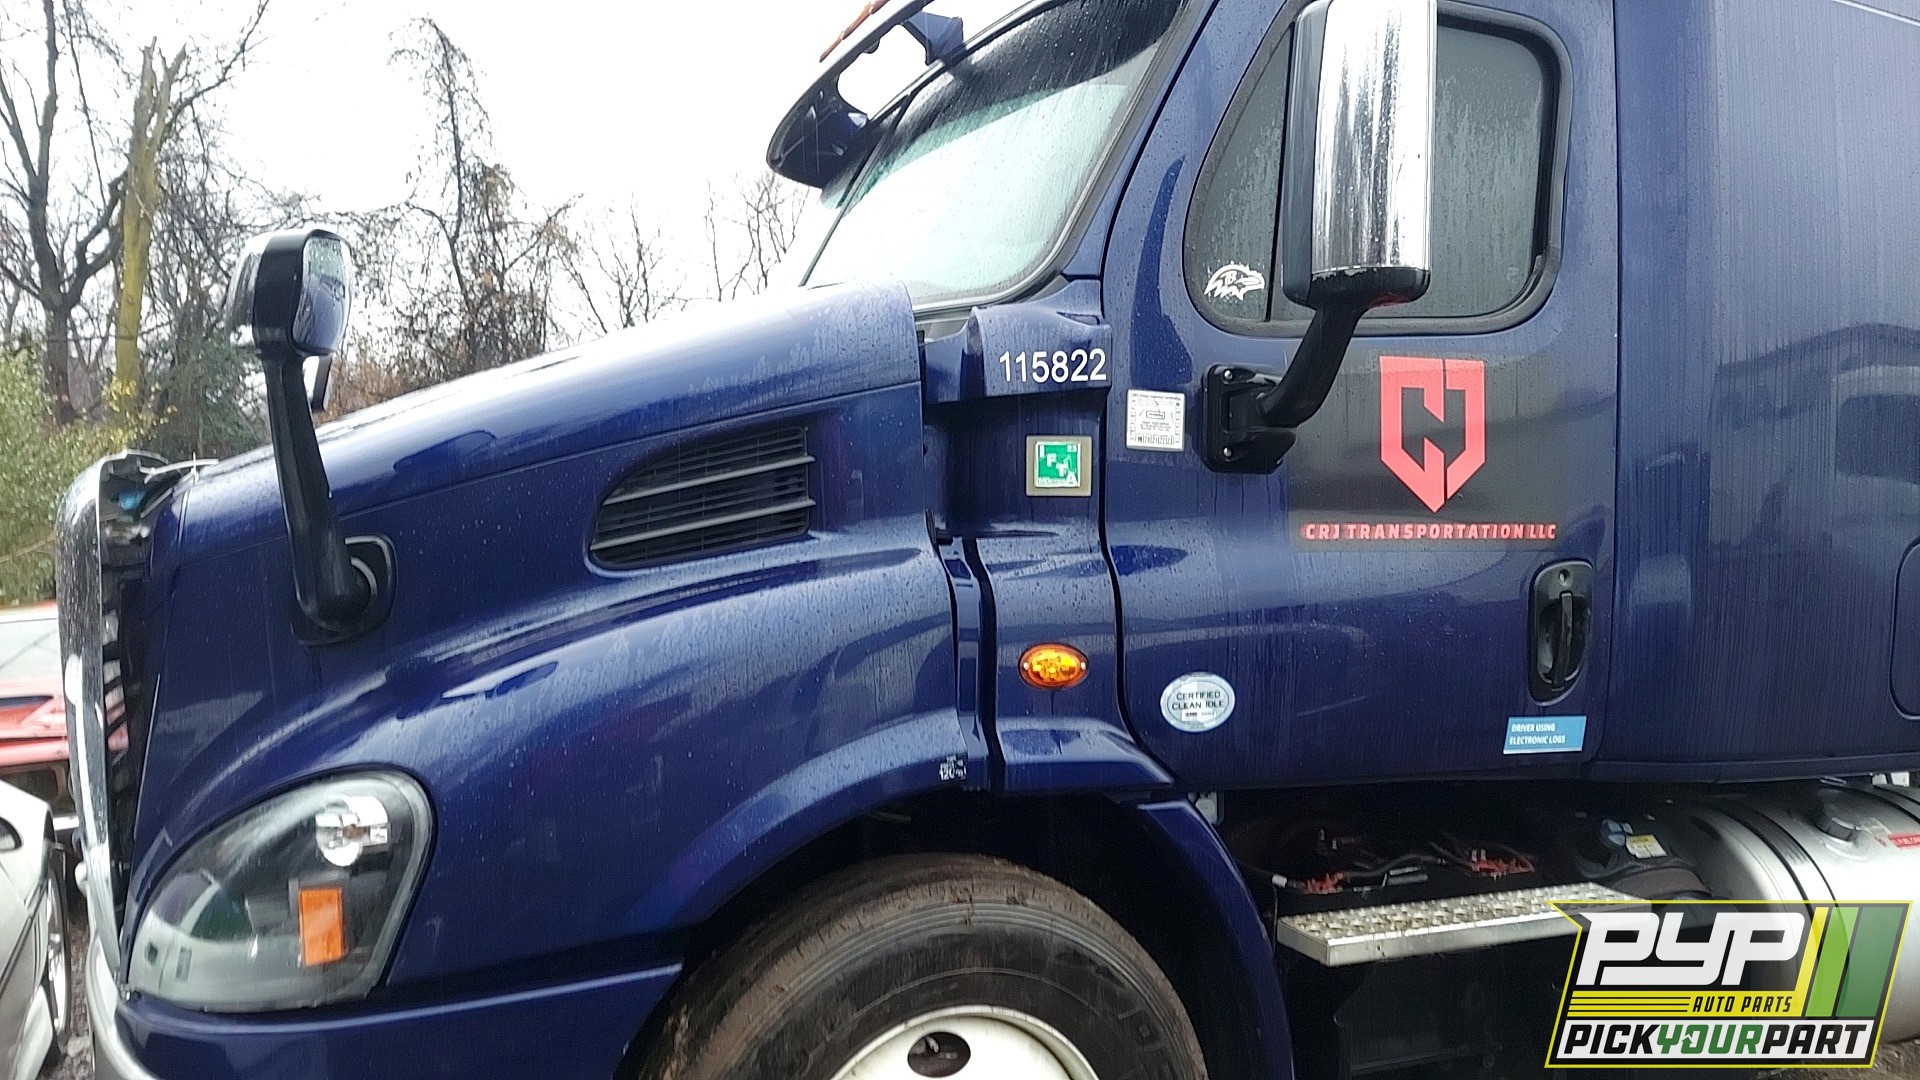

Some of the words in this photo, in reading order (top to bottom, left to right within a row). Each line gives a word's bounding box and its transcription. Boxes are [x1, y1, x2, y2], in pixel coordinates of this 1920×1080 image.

[1000, 348, 1107, 382] 115822
[1303, 523, 1340, 540] CRJ
[1345, 523, 1524, 540] TRANSPORTATION
[1529, 523, 1557, 540] LLC
[1176, 691, 1220, 700] CERTIFIED
[1171, 702, 1201, 710] CLEAN
[1511, 723, 1535, 732] DRIVER
[1535, 722, 1556, 732] USING
[1509, 735, 1547, 745] ELECTRONIC
[1548, 734, 1566, 744] LOGS
